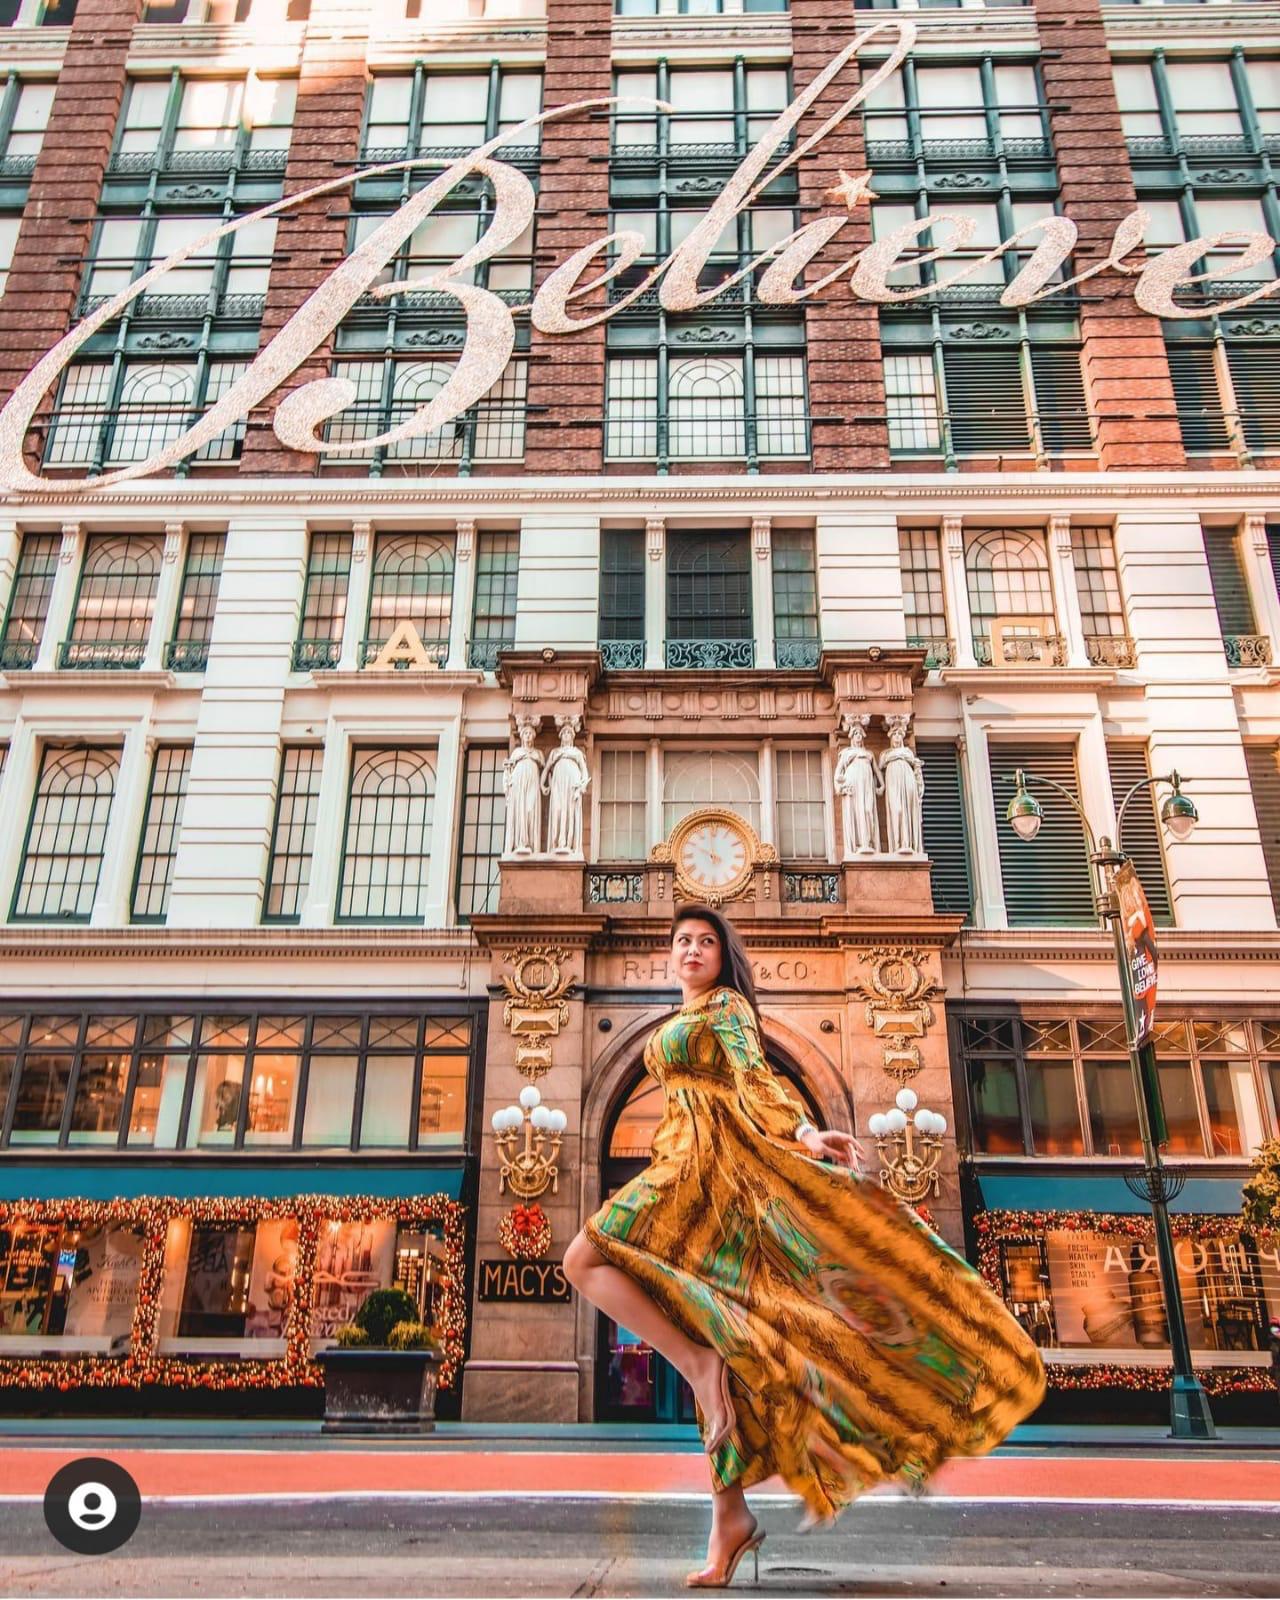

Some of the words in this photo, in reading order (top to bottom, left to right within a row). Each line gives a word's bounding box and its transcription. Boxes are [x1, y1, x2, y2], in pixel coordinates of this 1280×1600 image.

[0, 19, 1280, 492] Believe
[365, 620, 439, 671] A
[1069, 1253, 1098, 1261] HEALTHY
[1070, 1262, 1086, 1270] SKIN
[484, 1264, 567, 1296] MACY'S
[1071, 1271, 1096, 1280] STARTS
